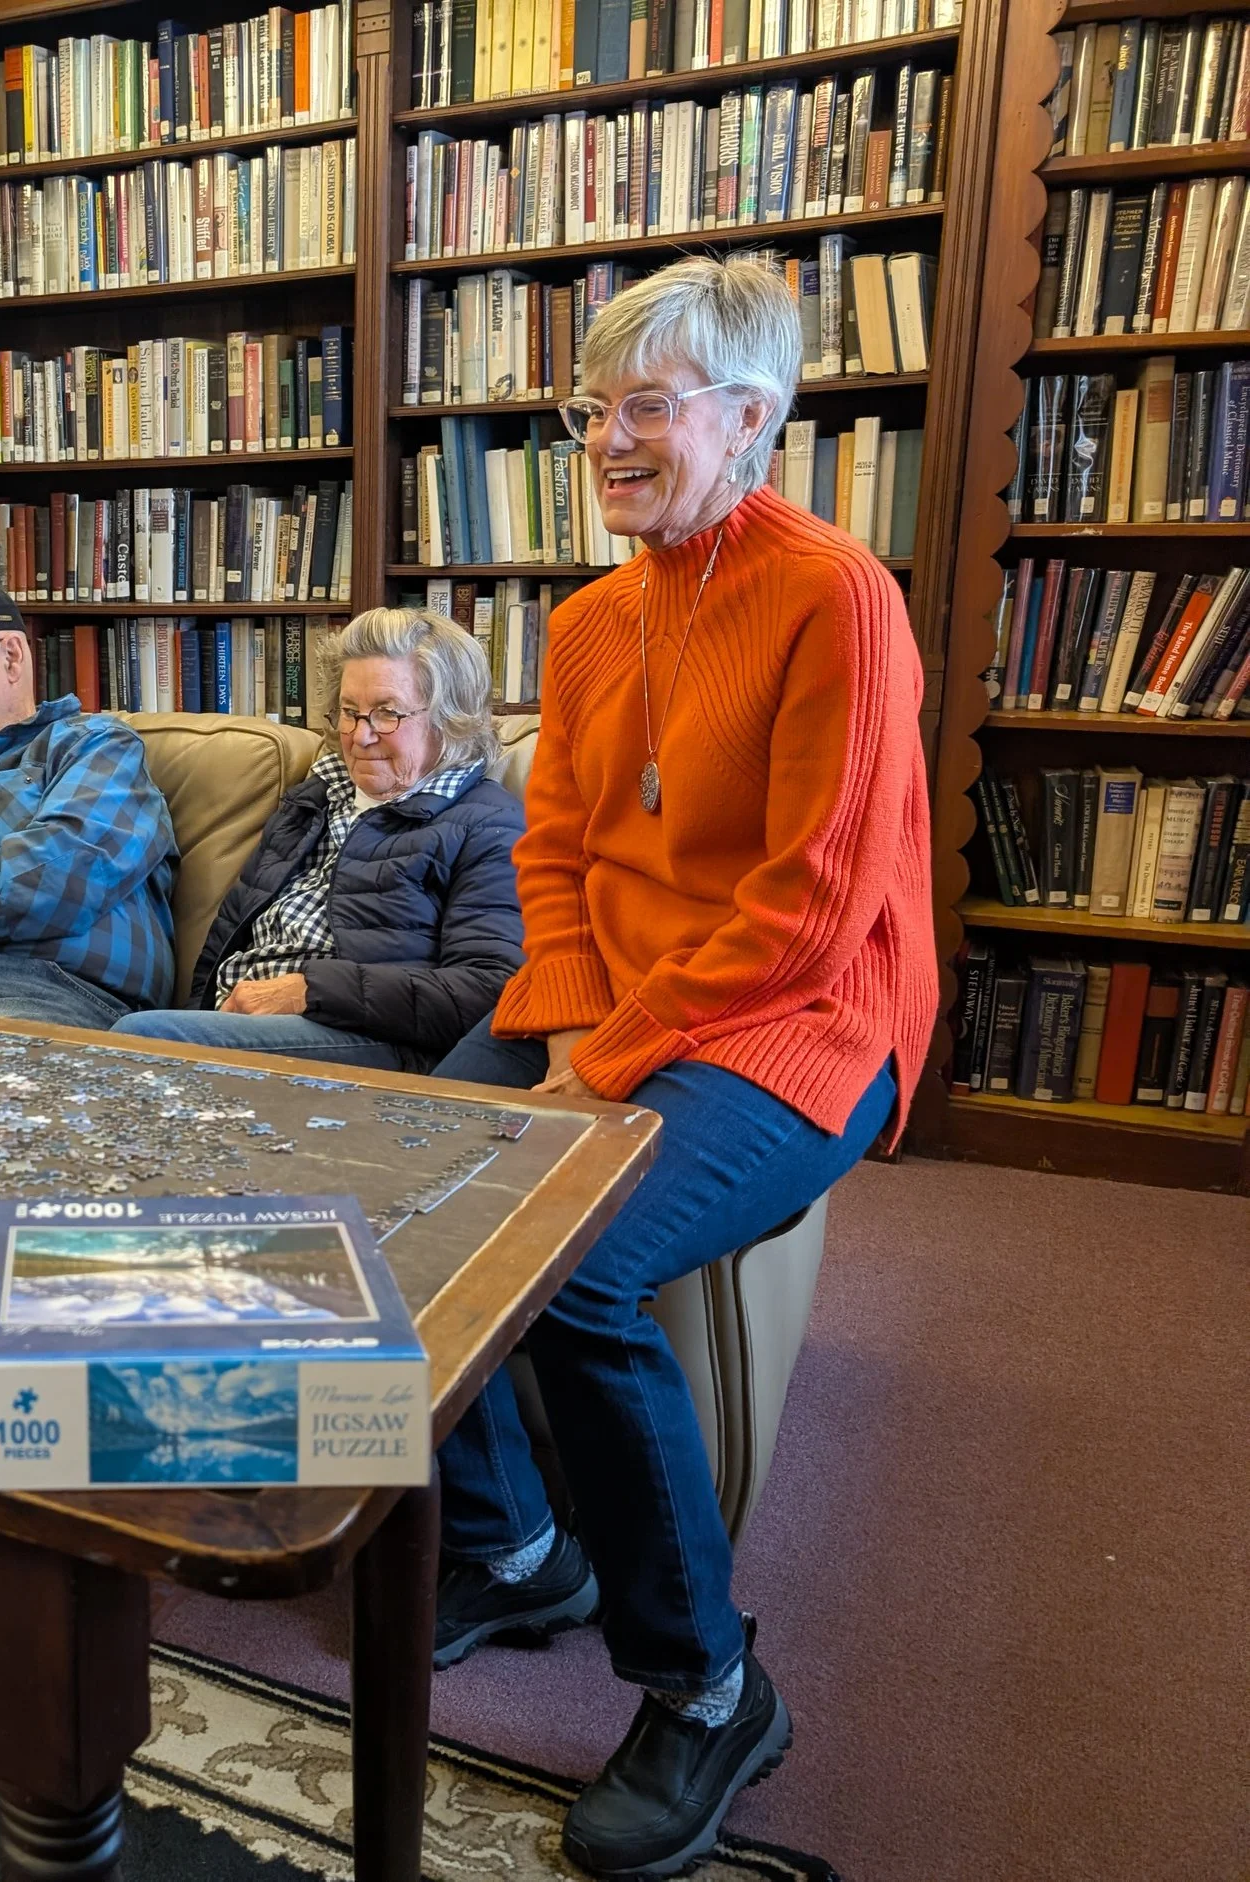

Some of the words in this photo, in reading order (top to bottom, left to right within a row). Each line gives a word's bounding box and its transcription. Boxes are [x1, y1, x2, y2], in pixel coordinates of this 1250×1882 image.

[1156, 65, 1169, 104] Americans
[720, 95, 741, 122] JEAN
[718, 124, 740, 167] HARRIS
[771, 133, 785, 162] FATAL
[894, 117, 907, 167] THIEVES
[616, 157, 628, 183] DOWN
[769, 163, 784, 196] VISION
[267, 180, 275, 205] BORN
[327, 160, 336, 212] SISTERHOOD
[327, 213, 335, 221] IS
[196, 217, 211, 252] Stiffed
[267, 217, 275, 255] LIBERTY
[326, 223, 335, 256] GLOBAL
[1144, 216, 1162, 264] Mozart's
[491, 277, 503, 333] PAPILLON
[1136, 292, 1152, 317] Year
[140, 348, 151, 388] Susan
[1226, 400, 1236, 408] of
[1235, 385, 1250, 441] Encyclopedic
[140, 404, 152, 449] Falud
[1224, 411, 1237, 448] Classical
[1221, 451, 1234, 477] Music
[1230, 444, 1246, 489] Dictionary
[553, 456, 568, 506] Fashion
[116, 502, 124, 535] Wilkerson
[121, 508, 129, 528] Isabel
[254, 523, 263, 545] Black
[116, 543, 130, 583] Caste
[252, 545, 261, 571] Power
[1129, 577, 1157, 635] PAVAROTTI
[156, 624, 168, 640] BOB
[292, 623, 301, 638] THE
[1181, 621, 1193, 635] The
[285, 634, 293, 663] POWER
[291, 639, 301, 662] PRICE
[1171, 636, 1186, 653] Band
[157, 641, 169, 688] WOODWARD
[218, 640, 226, 681] THIRTEEN
[1162, 655, 1179, 675] Name
[218, 684, 227, 704] DAYS
[291, 665, 301, 700] Seymour
[1152, 676, 1168, 695] Book
[1233, 860, 1246, 879] EARL
[1229, 880, 1244, 905] WILSO
[964, 969, 980, 1021] STEINWAY
[1059, 994, 1075, 1024] Baker's
[1038, 992, 1060, 1035] Dictionary
[1040, 1037, 1054, 1047] of
[1051, 1025, 1072, 1077] Biographical
[63, 1202, 143, 1219] 1000
[158, 1211, 248, 1224] PUZZLE
[254, 1208, 337, 1222] JIGSAW
[311, 1412, 410, 1435] JIGSAW
[3, 1447, 51, 1460] PIECES
[312, 1437, 409, 1459] PUZZLE
